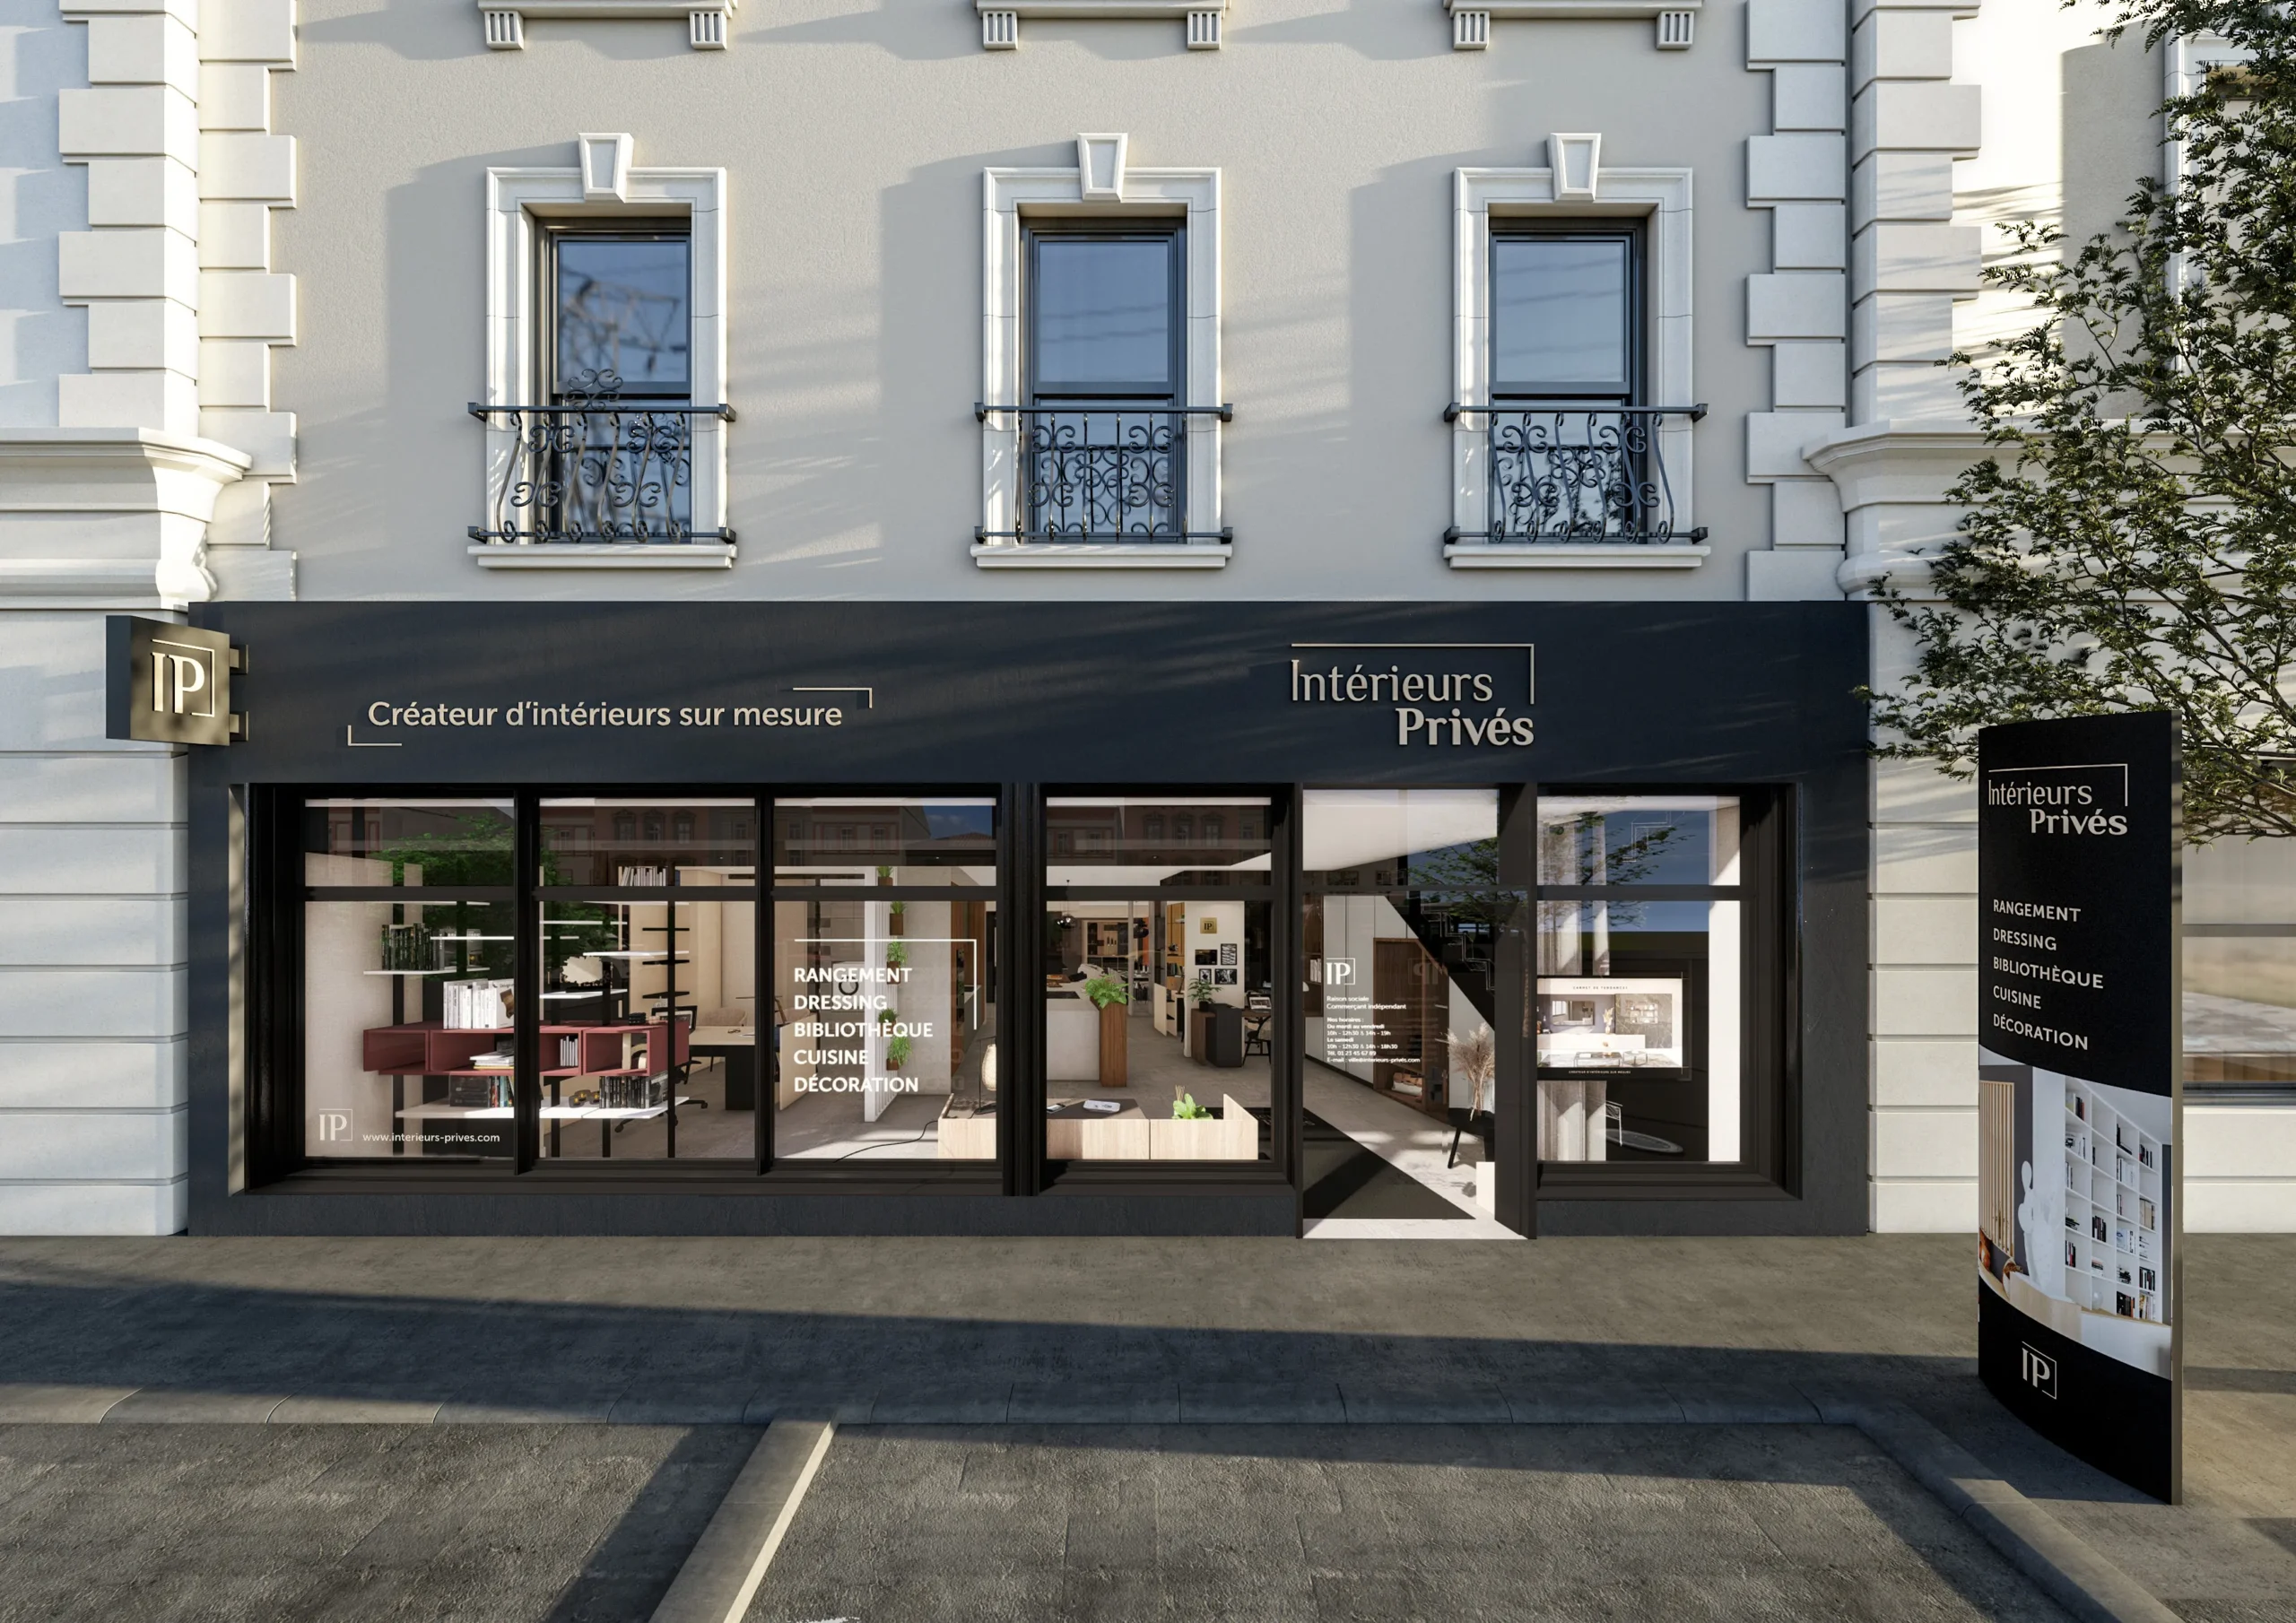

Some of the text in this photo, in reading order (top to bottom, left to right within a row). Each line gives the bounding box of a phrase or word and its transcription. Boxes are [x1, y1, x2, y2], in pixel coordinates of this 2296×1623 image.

[151, 651, 205, 714] IP
[1291, 659, 1493, 701] Intérieurs
[368, 701, 842, 726] Créateur d'intérieurs sur mesure
[1395, 707, 1535, 746] Privés
[1987, 779, 2092, 806] Intérieurs
[2030, 809, 2127, 836] Privés
[1993, 898, 2082, 923] RANGEMENT
[1993, 927, 2057, 951] DRESSING
[794, 968, 913, 983] RANGEMENT
[1326, 962, 1352, 985] IP
[1993, 956, 2104, 989] BIBLIOTHÈQUE
[794, 994, 888, 1011] DRESSING
[1993, 985, 2042, 1010] CUISINE
[794, 1020, 934, 1037] BIBLIOTHÈQUE
[1993, 1013, 2089, 1051] DÉCORATION
[793, 1049, 869, 1065] CUISINE
[794, 1073, 919, 1093] DÉCORATION
[318, 1114, 500, 1144] IP www.interieurs-prives.com
[2022, 1347, 2050, 1388] IP
